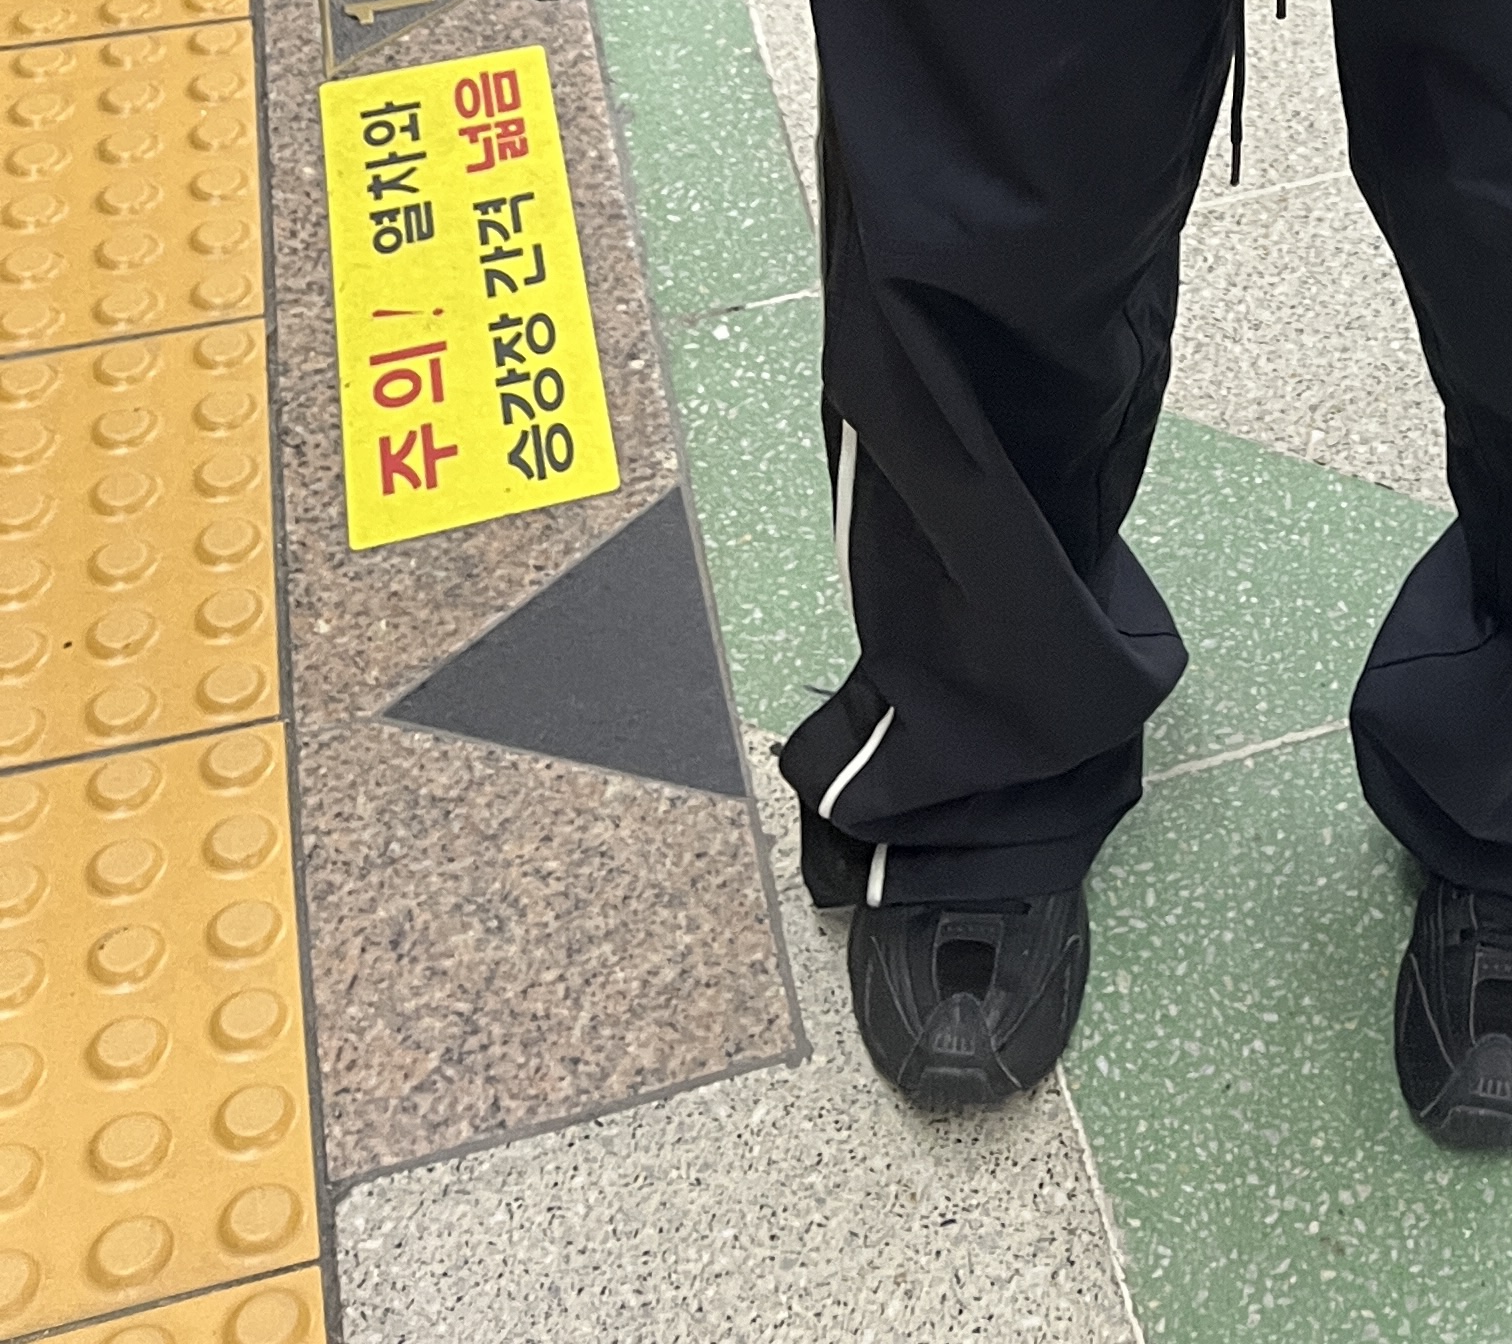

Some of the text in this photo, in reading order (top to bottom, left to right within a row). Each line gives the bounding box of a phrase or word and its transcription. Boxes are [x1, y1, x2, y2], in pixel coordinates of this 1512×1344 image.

[360, 100, 459, 496] 주의! 열차와
[454, 69, 574, 481] 승강장 간격 넓음
